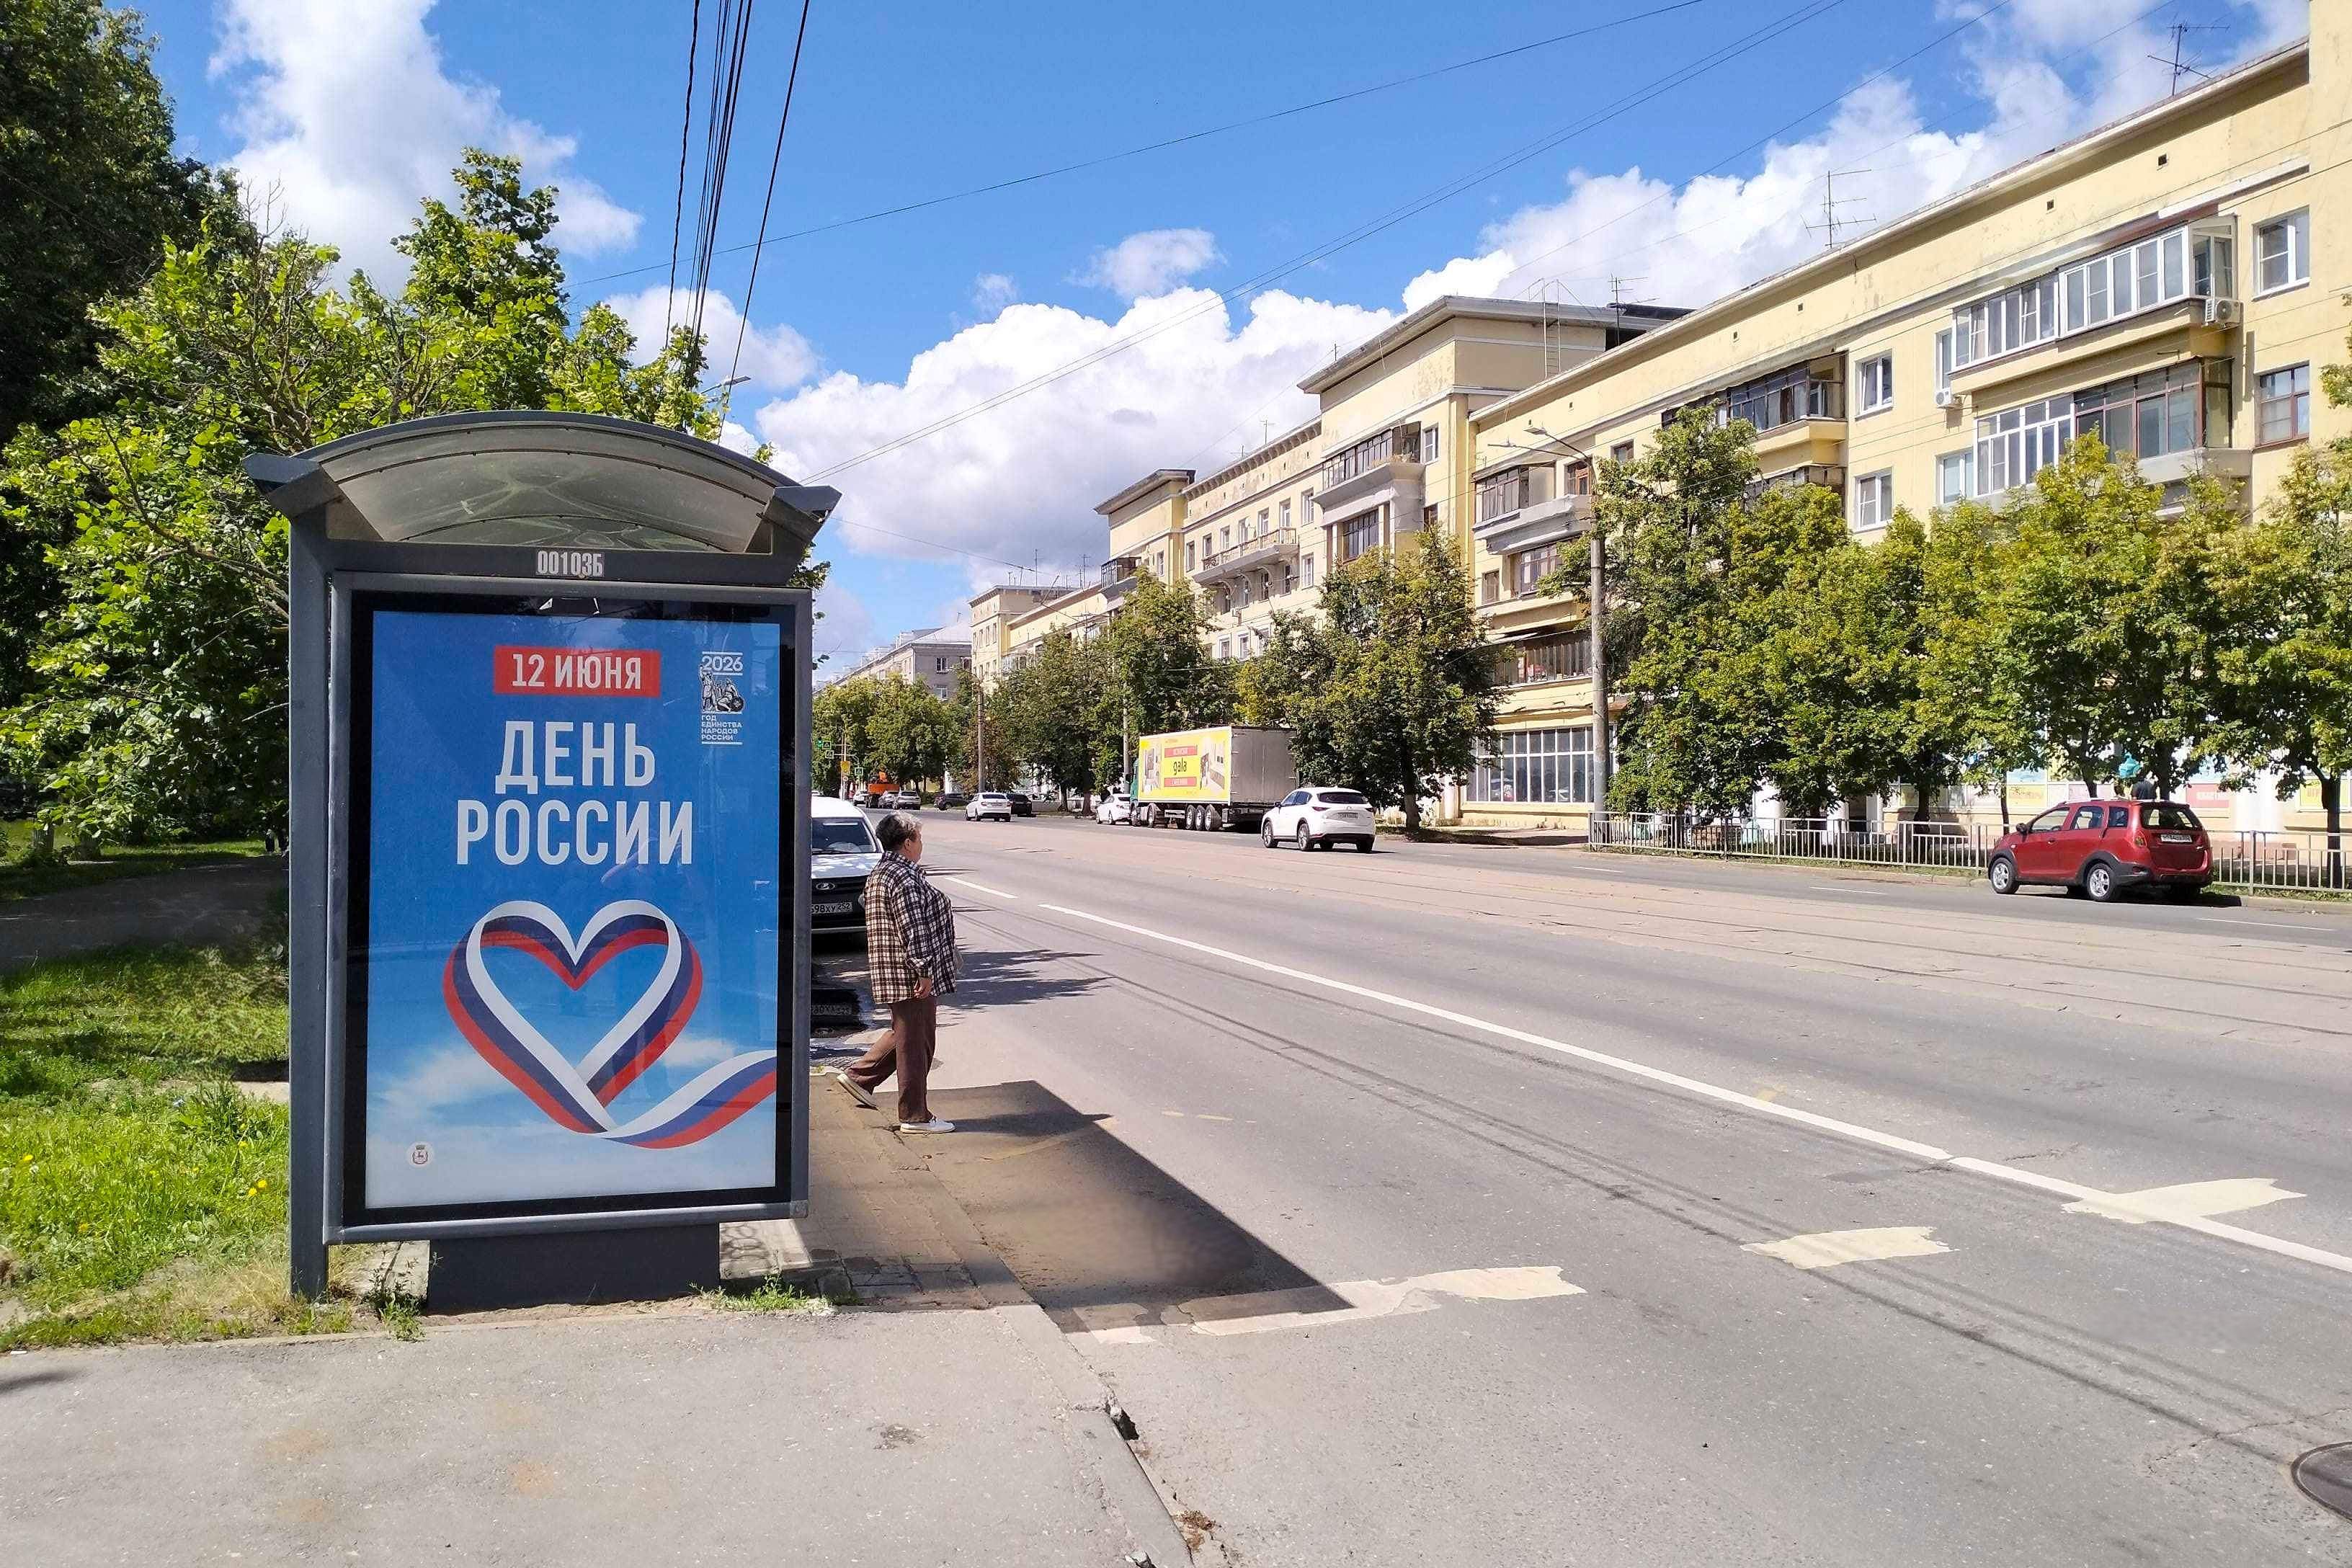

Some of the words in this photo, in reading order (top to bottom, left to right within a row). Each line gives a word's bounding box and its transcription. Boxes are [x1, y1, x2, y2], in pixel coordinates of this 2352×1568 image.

[538, 551, 603, 577] 00103Б
[512, 654, 545, 687] 12
[555, 655, 641, 690] ИЮНЯ
[702, 655, 743, 672] 2026
[495, 721, 655, 794] ДЕНЬ
[1173, 757, 1188, 775] gala
[457, 799, 692, 865] РОССИИ
